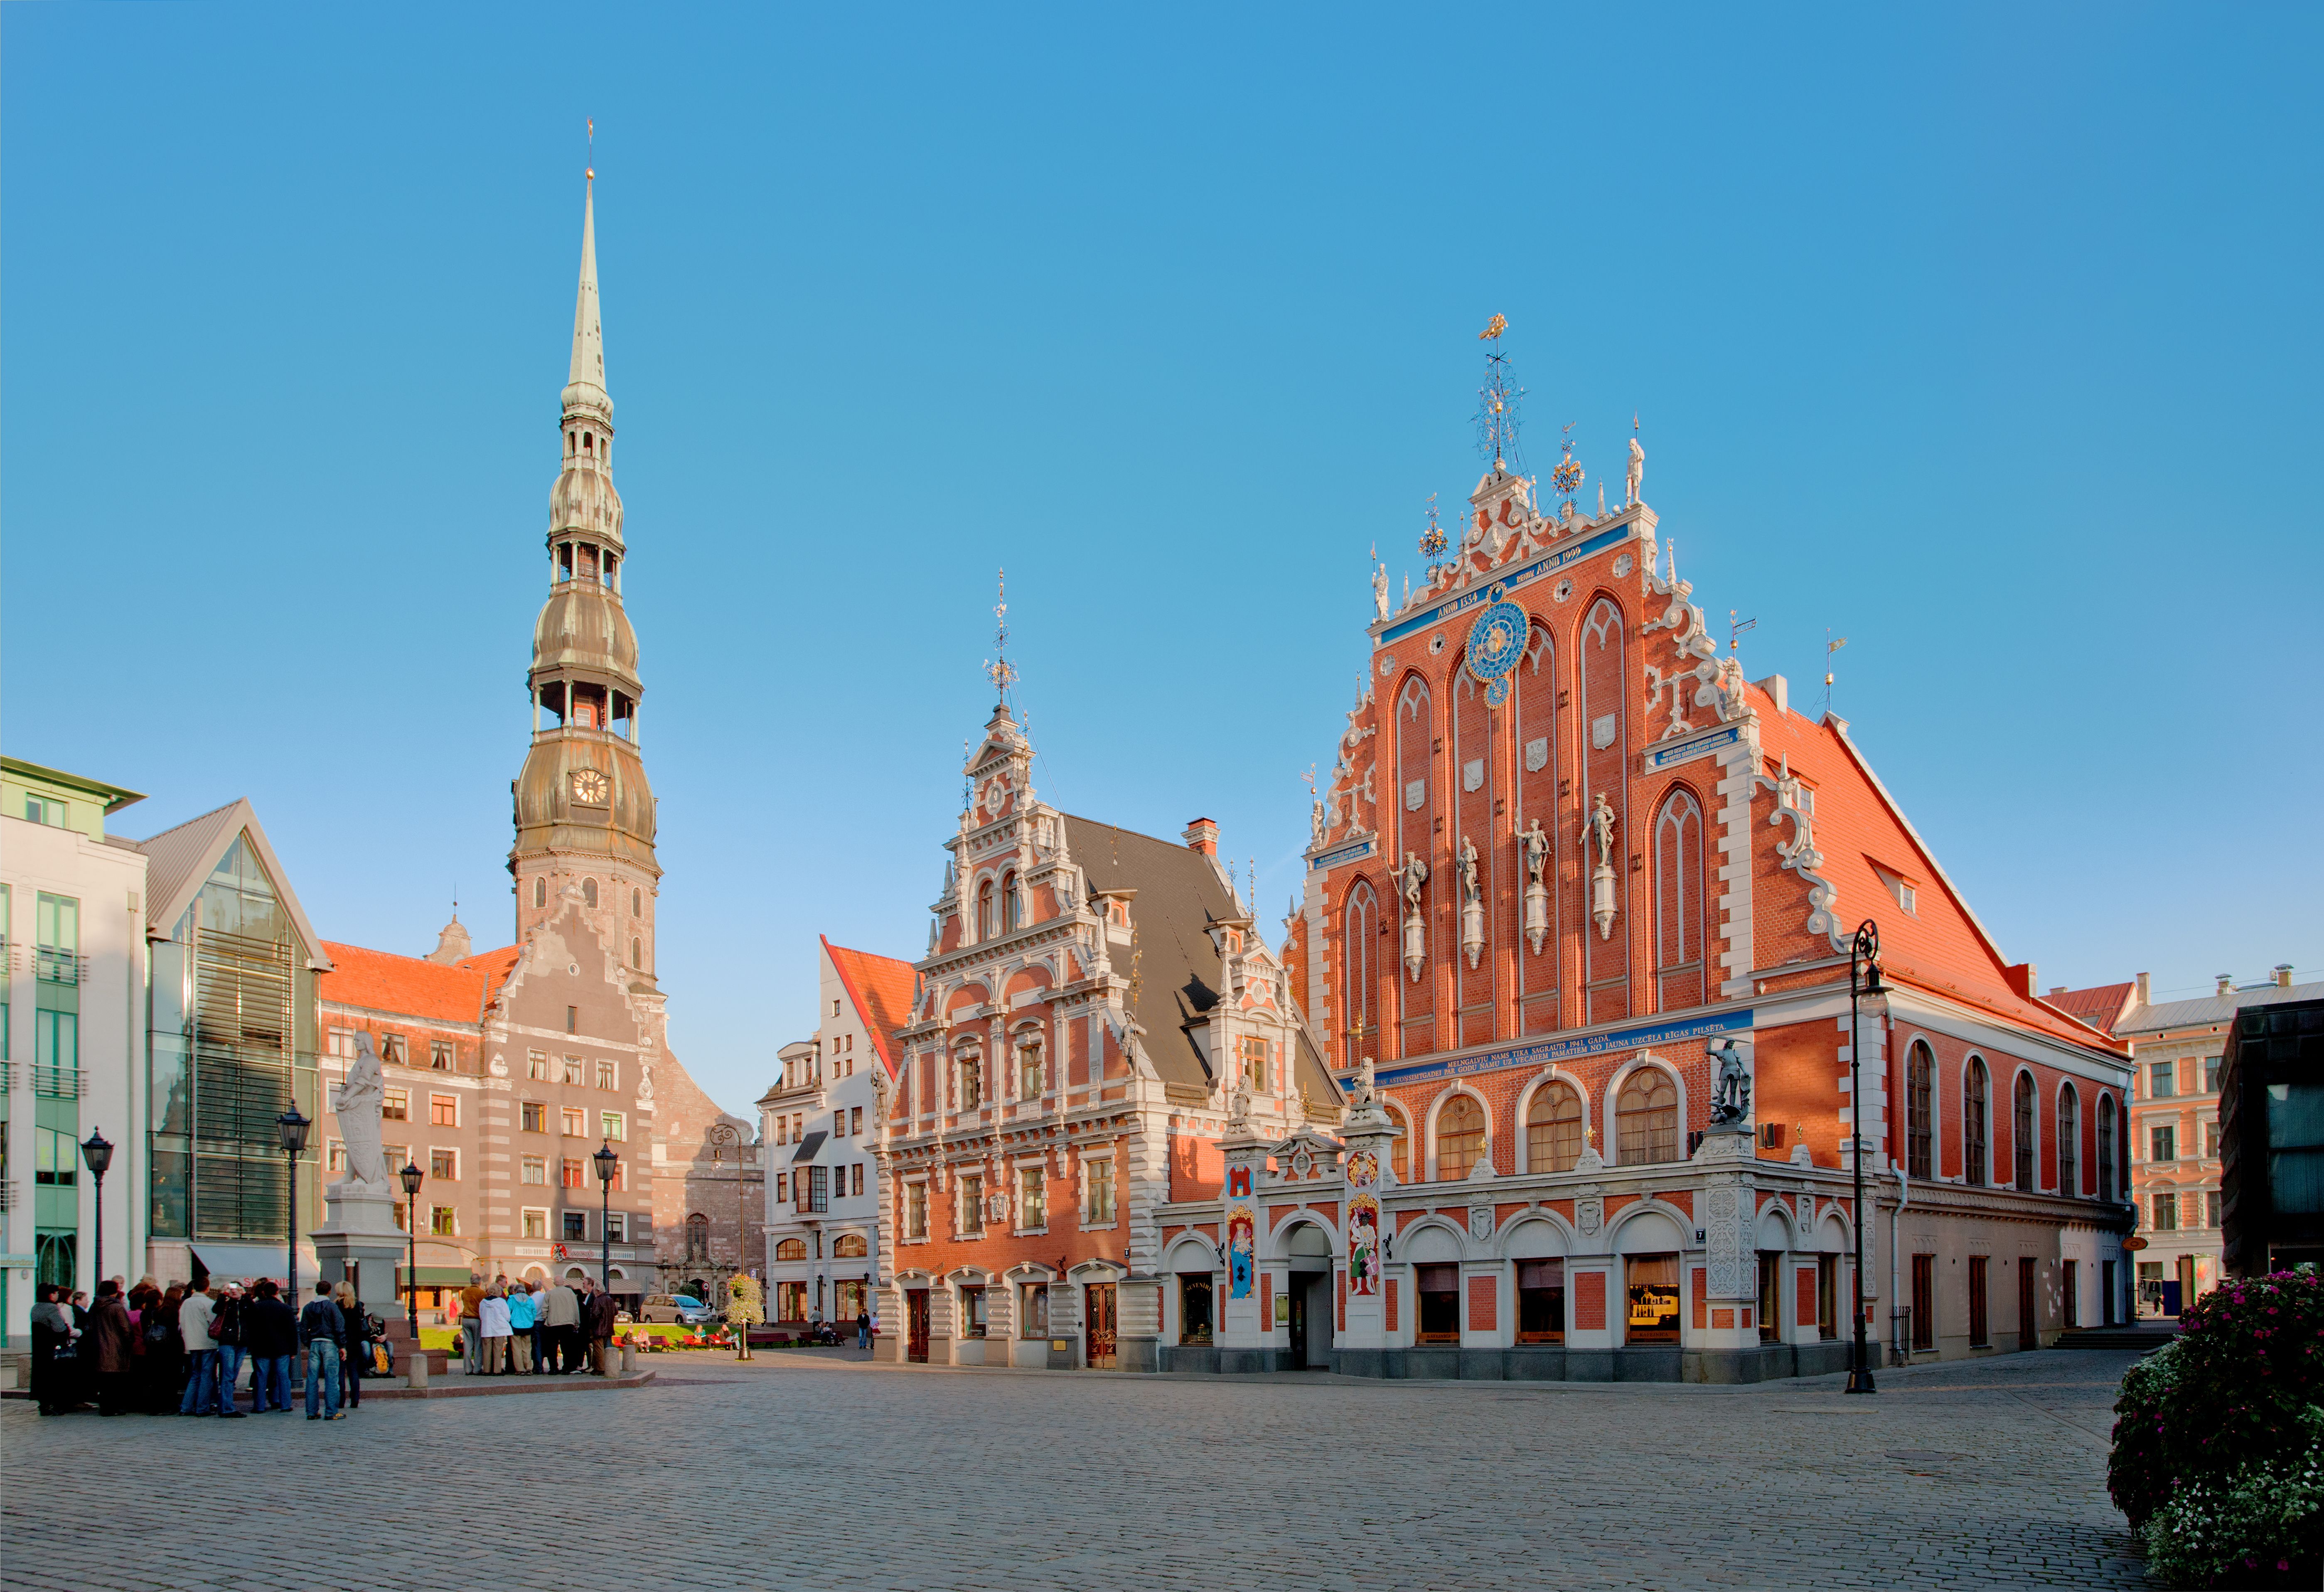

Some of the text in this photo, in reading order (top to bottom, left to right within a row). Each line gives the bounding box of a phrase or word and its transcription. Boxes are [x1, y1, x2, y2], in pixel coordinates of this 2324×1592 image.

[1536, 555, 1560, 575] ANNO
[1562, 546, 1581, 563] 1999
[1437, 592, 1478, 619] ANNO 1334
[1448, 1056, 1488, 1068] MELNGALVJU
[1532, 1043, 1566, 1054] SAGRAUTS
[1588, 1034, 1611, 1044] GADĀ.
[1458, 1064, 1477, 1073] GODU
[1515, 1053, 1548, 1064] VECAJIEM
[1552, 1046, 1587, 1057] PAMATIEM
[1605, 1039, 1629, 1050] JAUNA
[1632, 1034, 1662, 1044] UZCĒLA
[1665, 1029, 1689, 1039] RĪGAS
[751, 1270, 755, 1278] P
